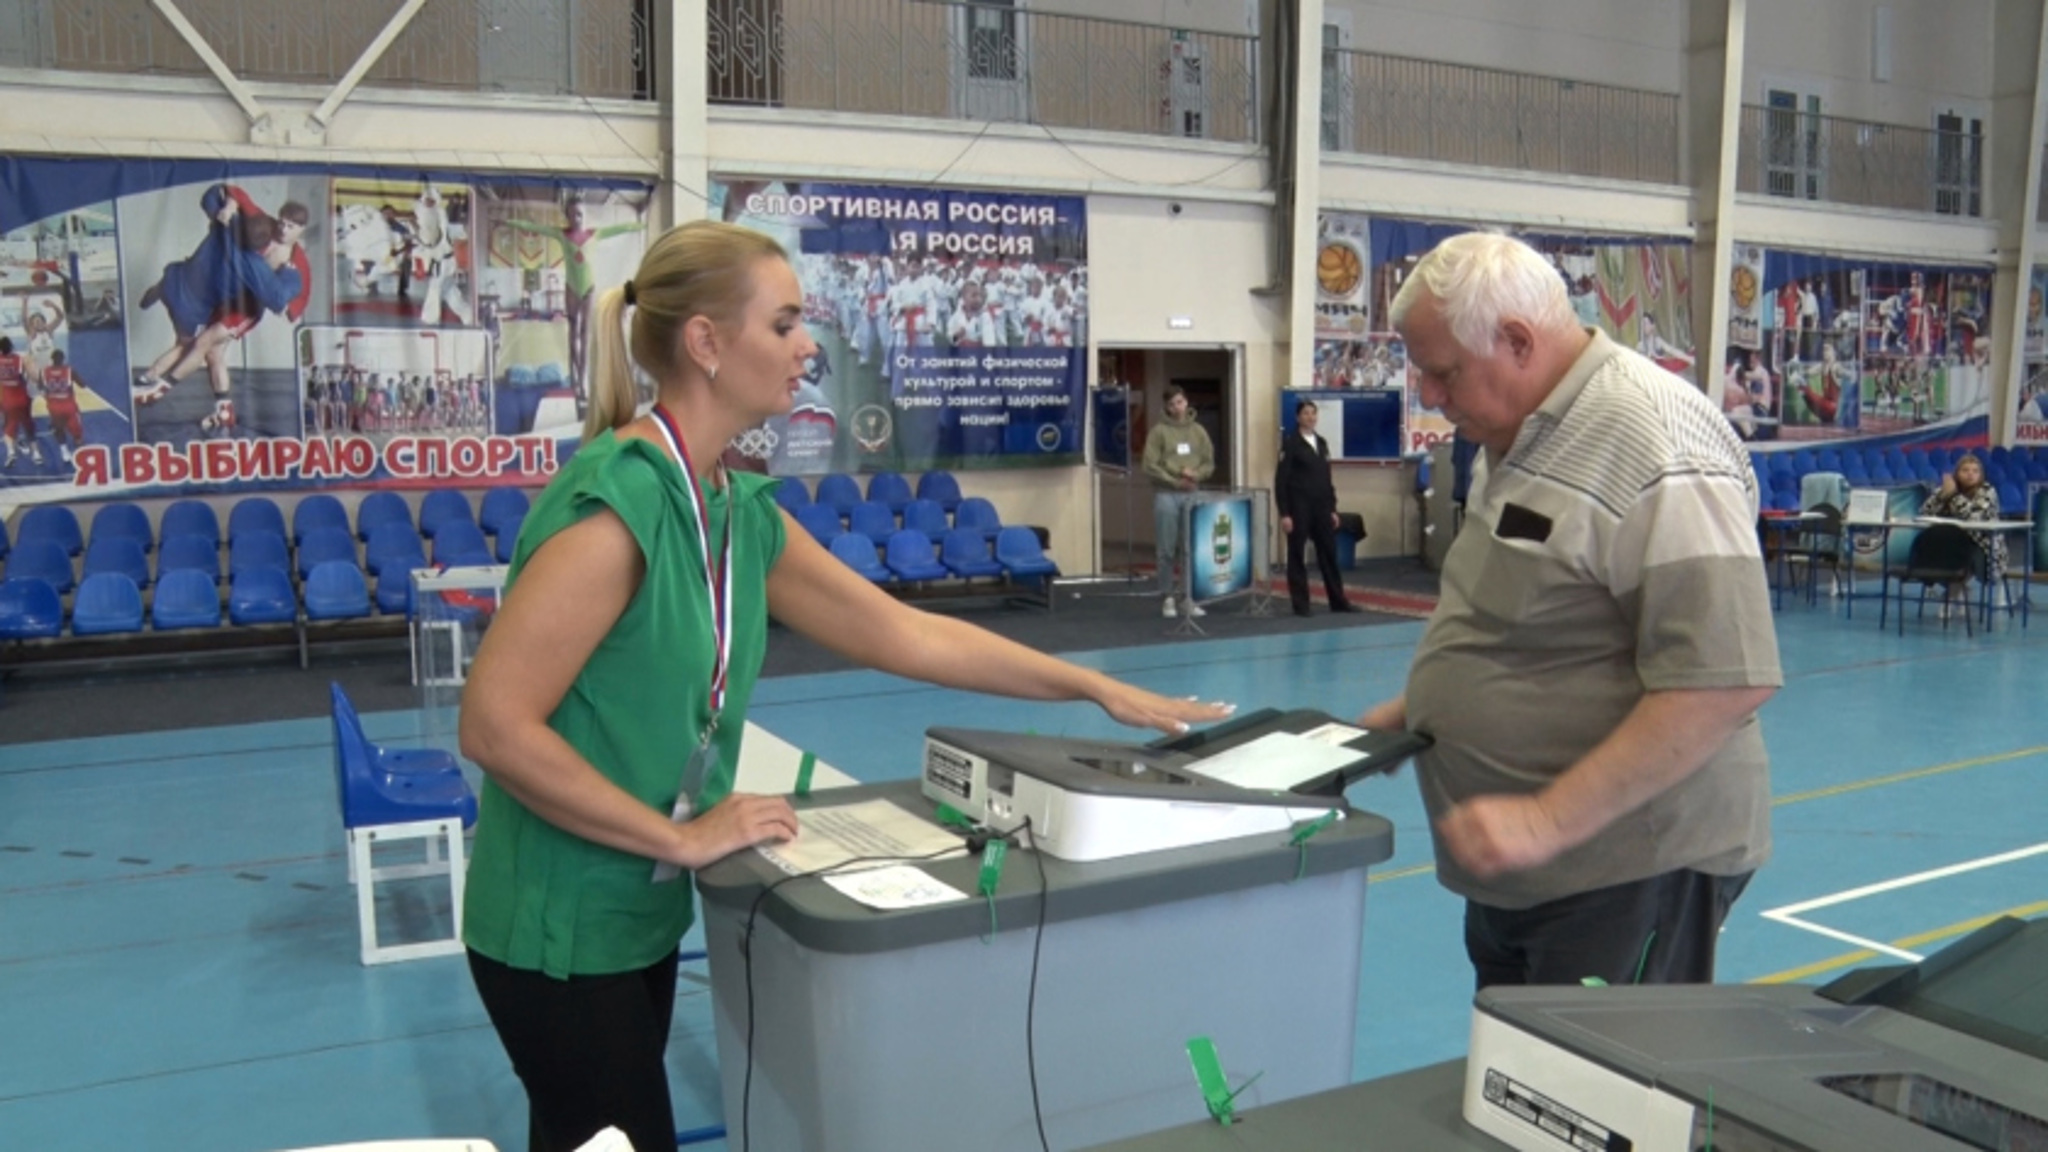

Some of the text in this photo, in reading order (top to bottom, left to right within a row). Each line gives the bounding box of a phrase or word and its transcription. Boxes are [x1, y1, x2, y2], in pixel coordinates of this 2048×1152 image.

[744, 192, 940, 221] СПОРТИВНАЯ
[926, 231, 1035, 255] РОССИЯ
[896, 354, 1069, 371] От занятий физической
[903, 374, 976, 391] культурой
[979, 377, 991, 388] и
[994, 377, 1054, 391] спортом
[894, 395, 1071, 410] прямо зависит здоровье
[959, 411, 1010, 426] нации!
[74, 436, 558, 486] Я ВЫБИРАЮ СПОРТ!
